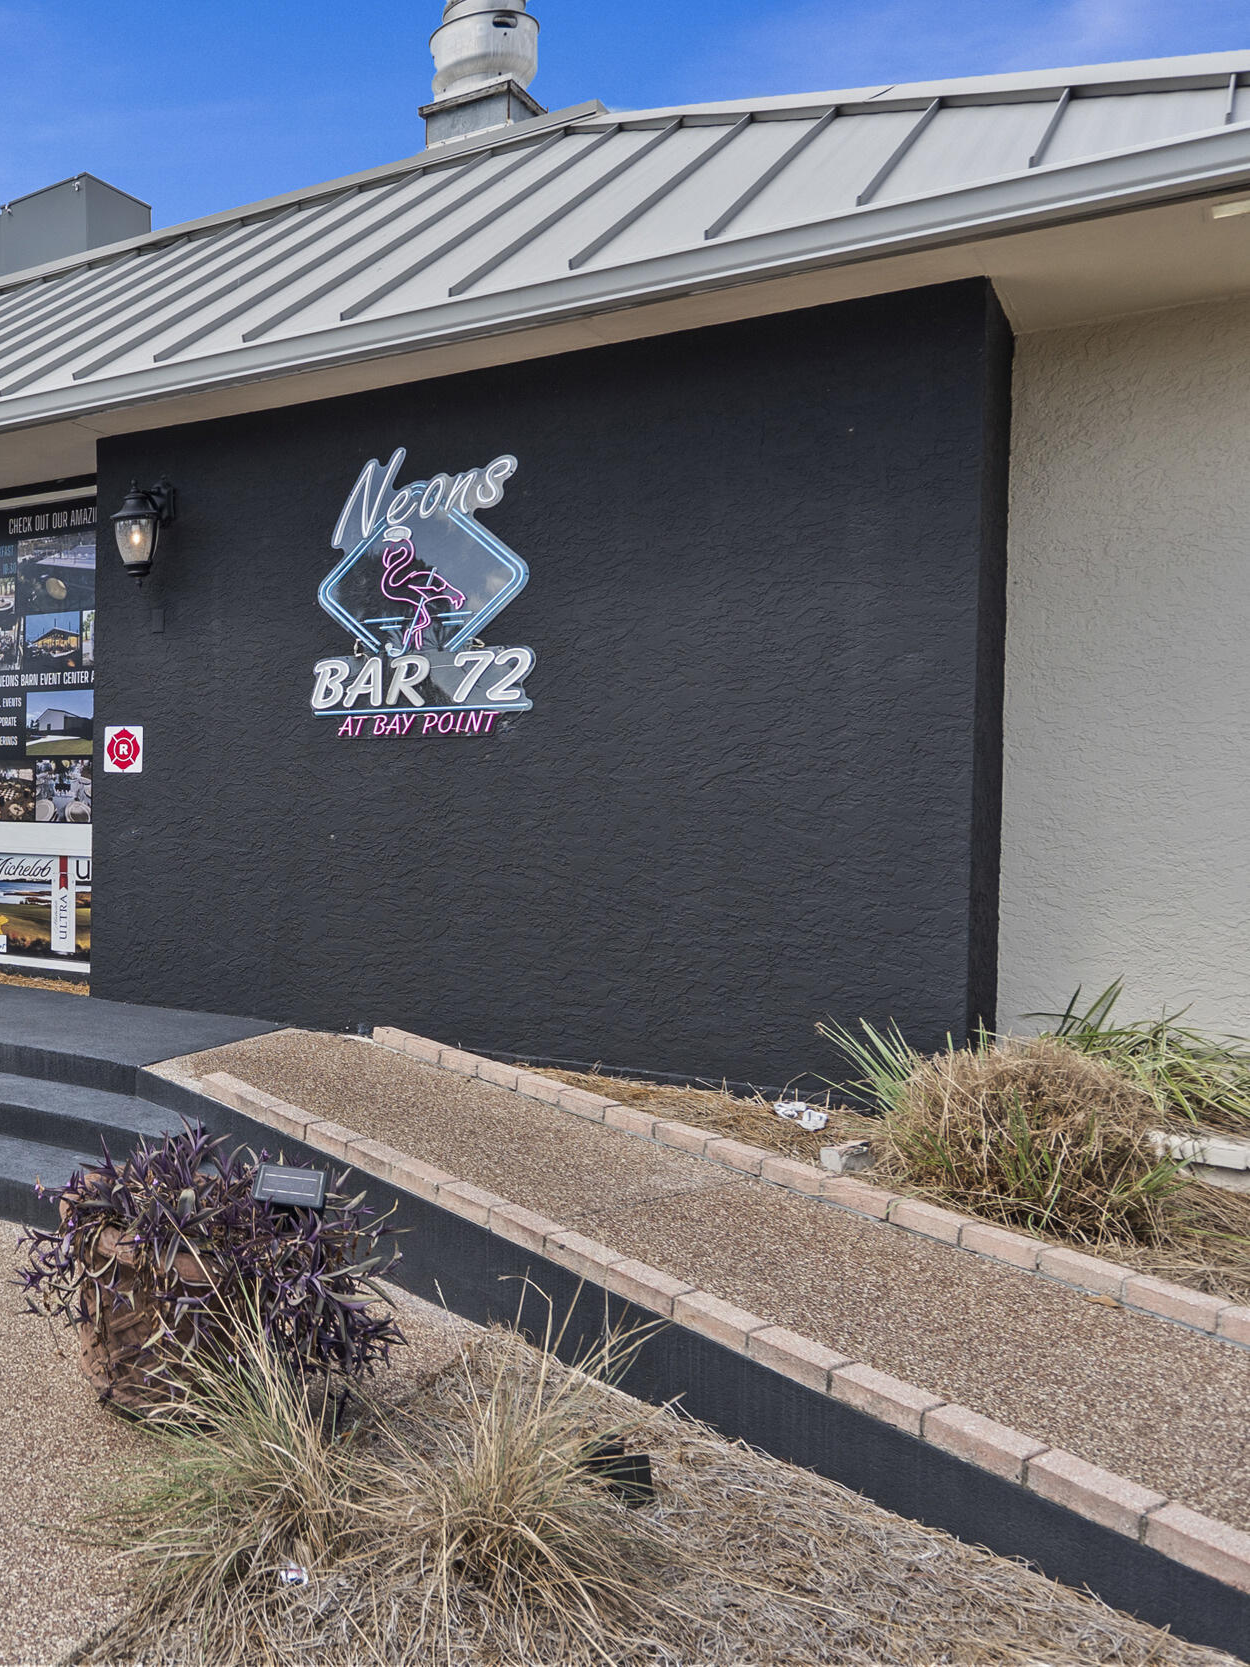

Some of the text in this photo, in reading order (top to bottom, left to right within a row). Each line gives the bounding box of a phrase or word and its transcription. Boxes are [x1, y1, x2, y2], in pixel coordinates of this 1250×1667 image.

[332, 448, 516, 546] Neons
[9, 516, 32, 534] CHECK
[35, 514, 49, 531] OUT
[52, 511, 68, 529] OUR
[20, 673, 38, 686] BARN
[40, 671, 61, 686] EVENT
[63, 670, 89, 684] CENTER
[311, 648, 533, 710] BAR 72
[3, 697, 22, 707] EVENTS
[338, 710, 500, 737] AT BAY POINT
[119, 743, 129, 755] R
[59, 894, 67, 940] ULTRA
